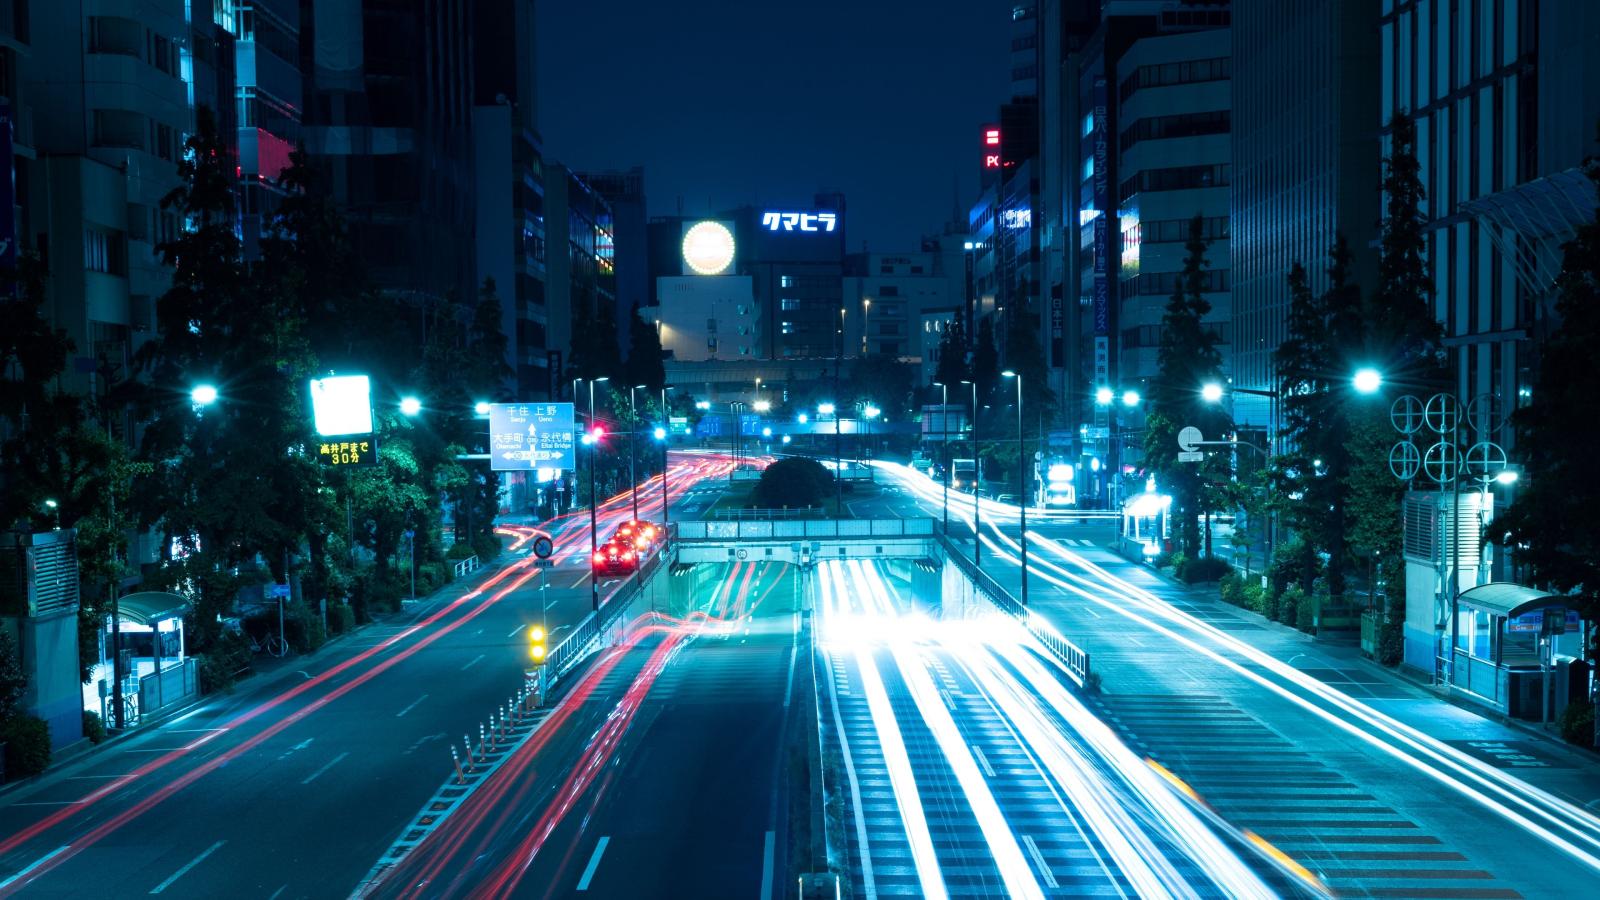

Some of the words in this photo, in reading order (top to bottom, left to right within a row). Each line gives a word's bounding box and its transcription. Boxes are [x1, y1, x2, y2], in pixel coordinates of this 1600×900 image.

[762, 212, 836, 232] クマヒラ
[507, 406, 529, 416] 千住
[535, 406, 557, 416] 上野
[492, 432, 524, 443] 大手町
[540, 432, 572, 442] 永代橋
[320, 441, 369, 454] 高井戸まで
